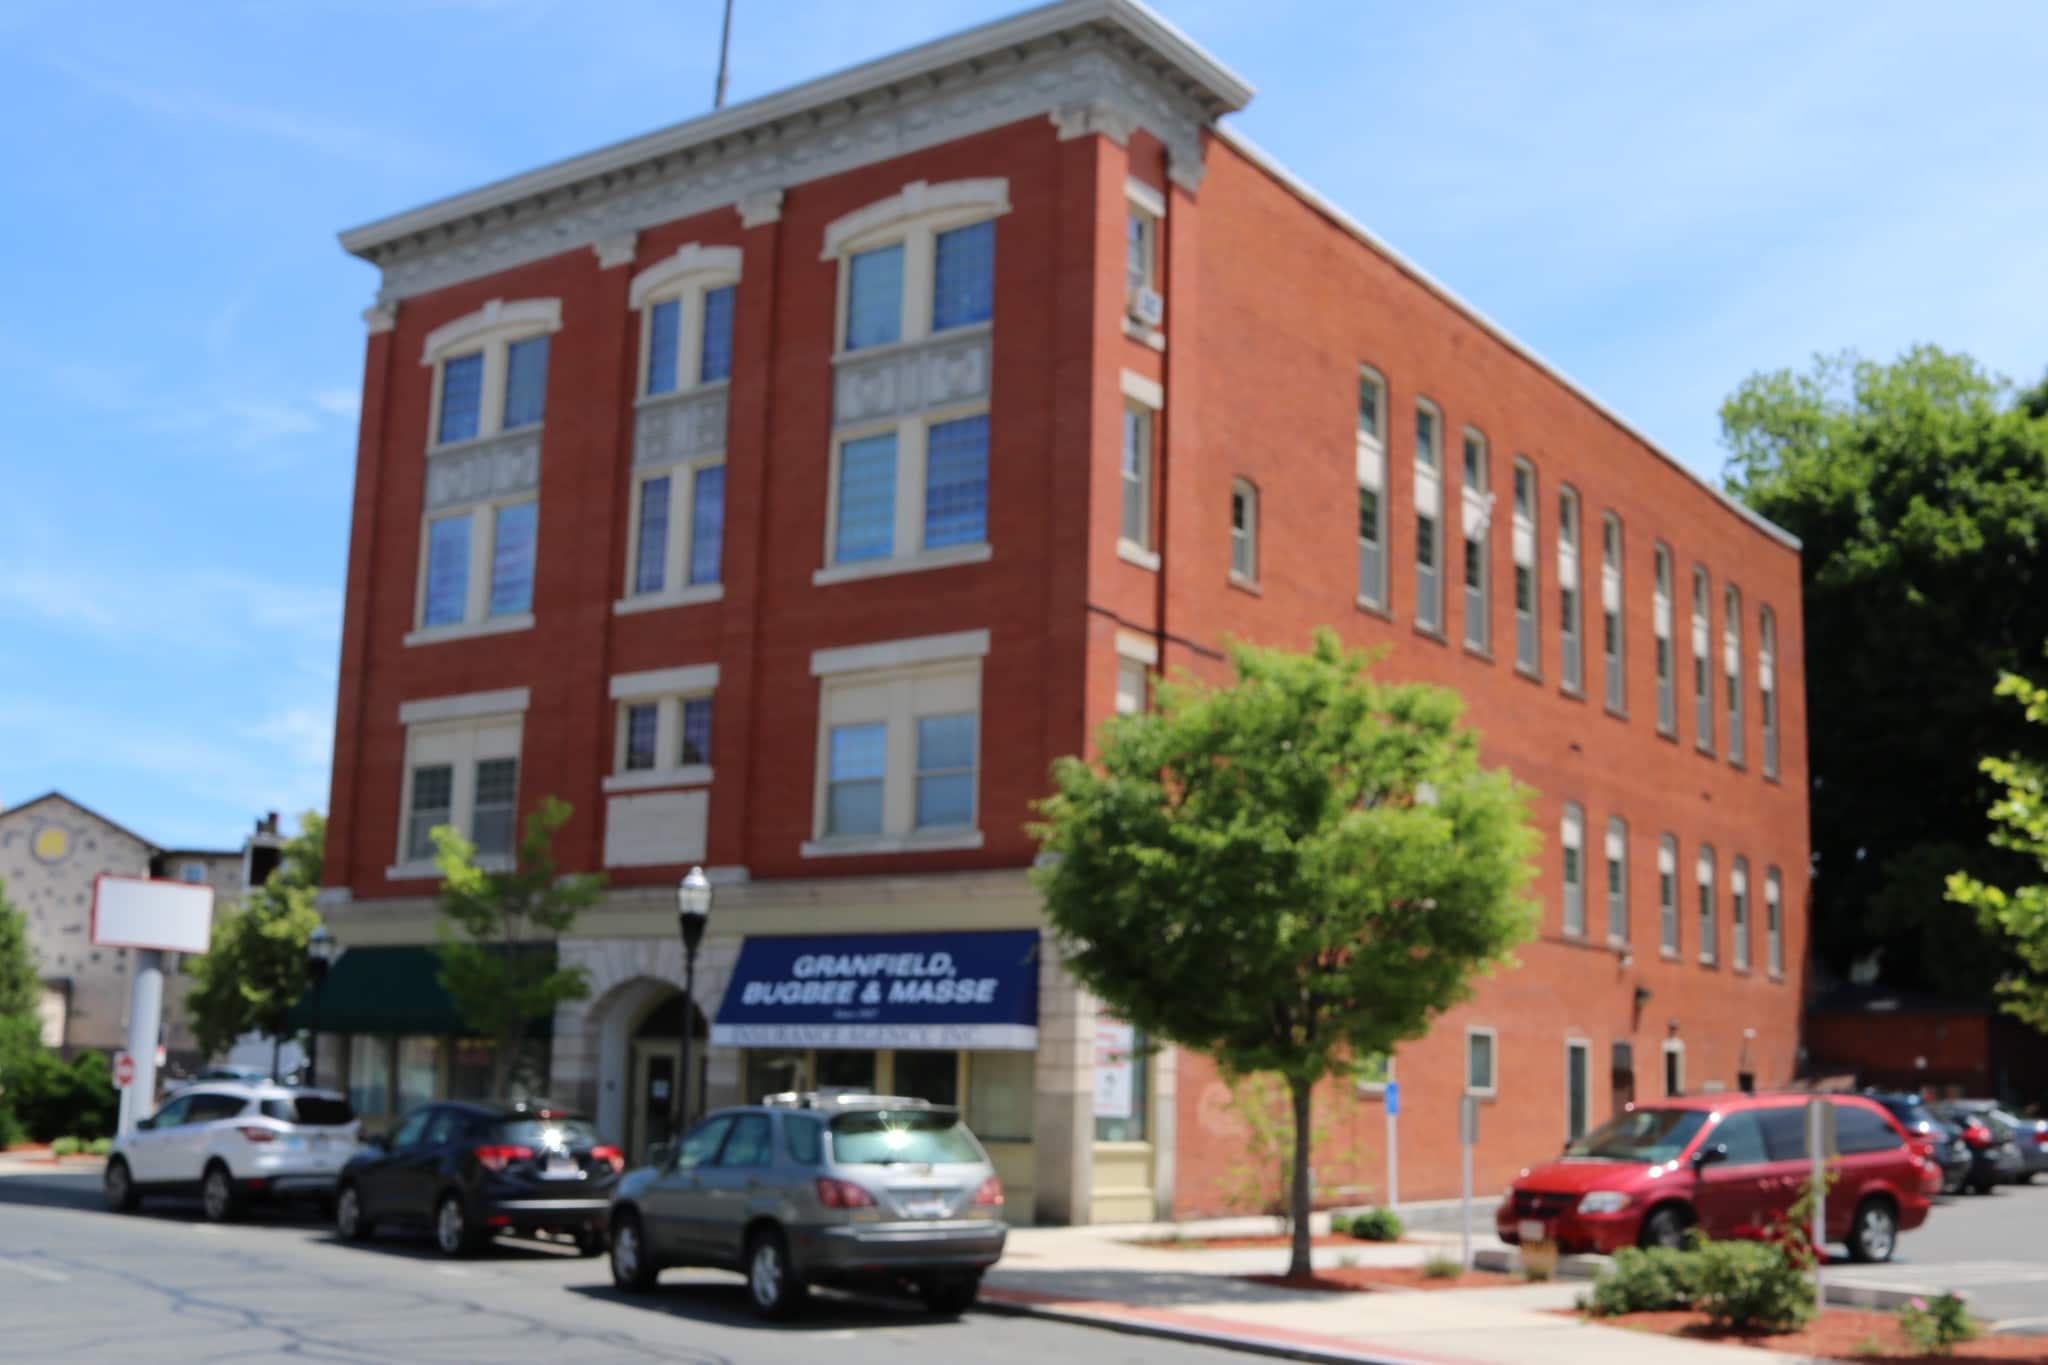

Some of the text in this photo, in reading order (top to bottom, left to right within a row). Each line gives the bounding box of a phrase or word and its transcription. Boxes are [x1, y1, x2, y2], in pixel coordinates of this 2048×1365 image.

[793, 952, 957, 978] GRANFIELD,
[741, 978, 998, 1005] BUGBEE & MASSE
